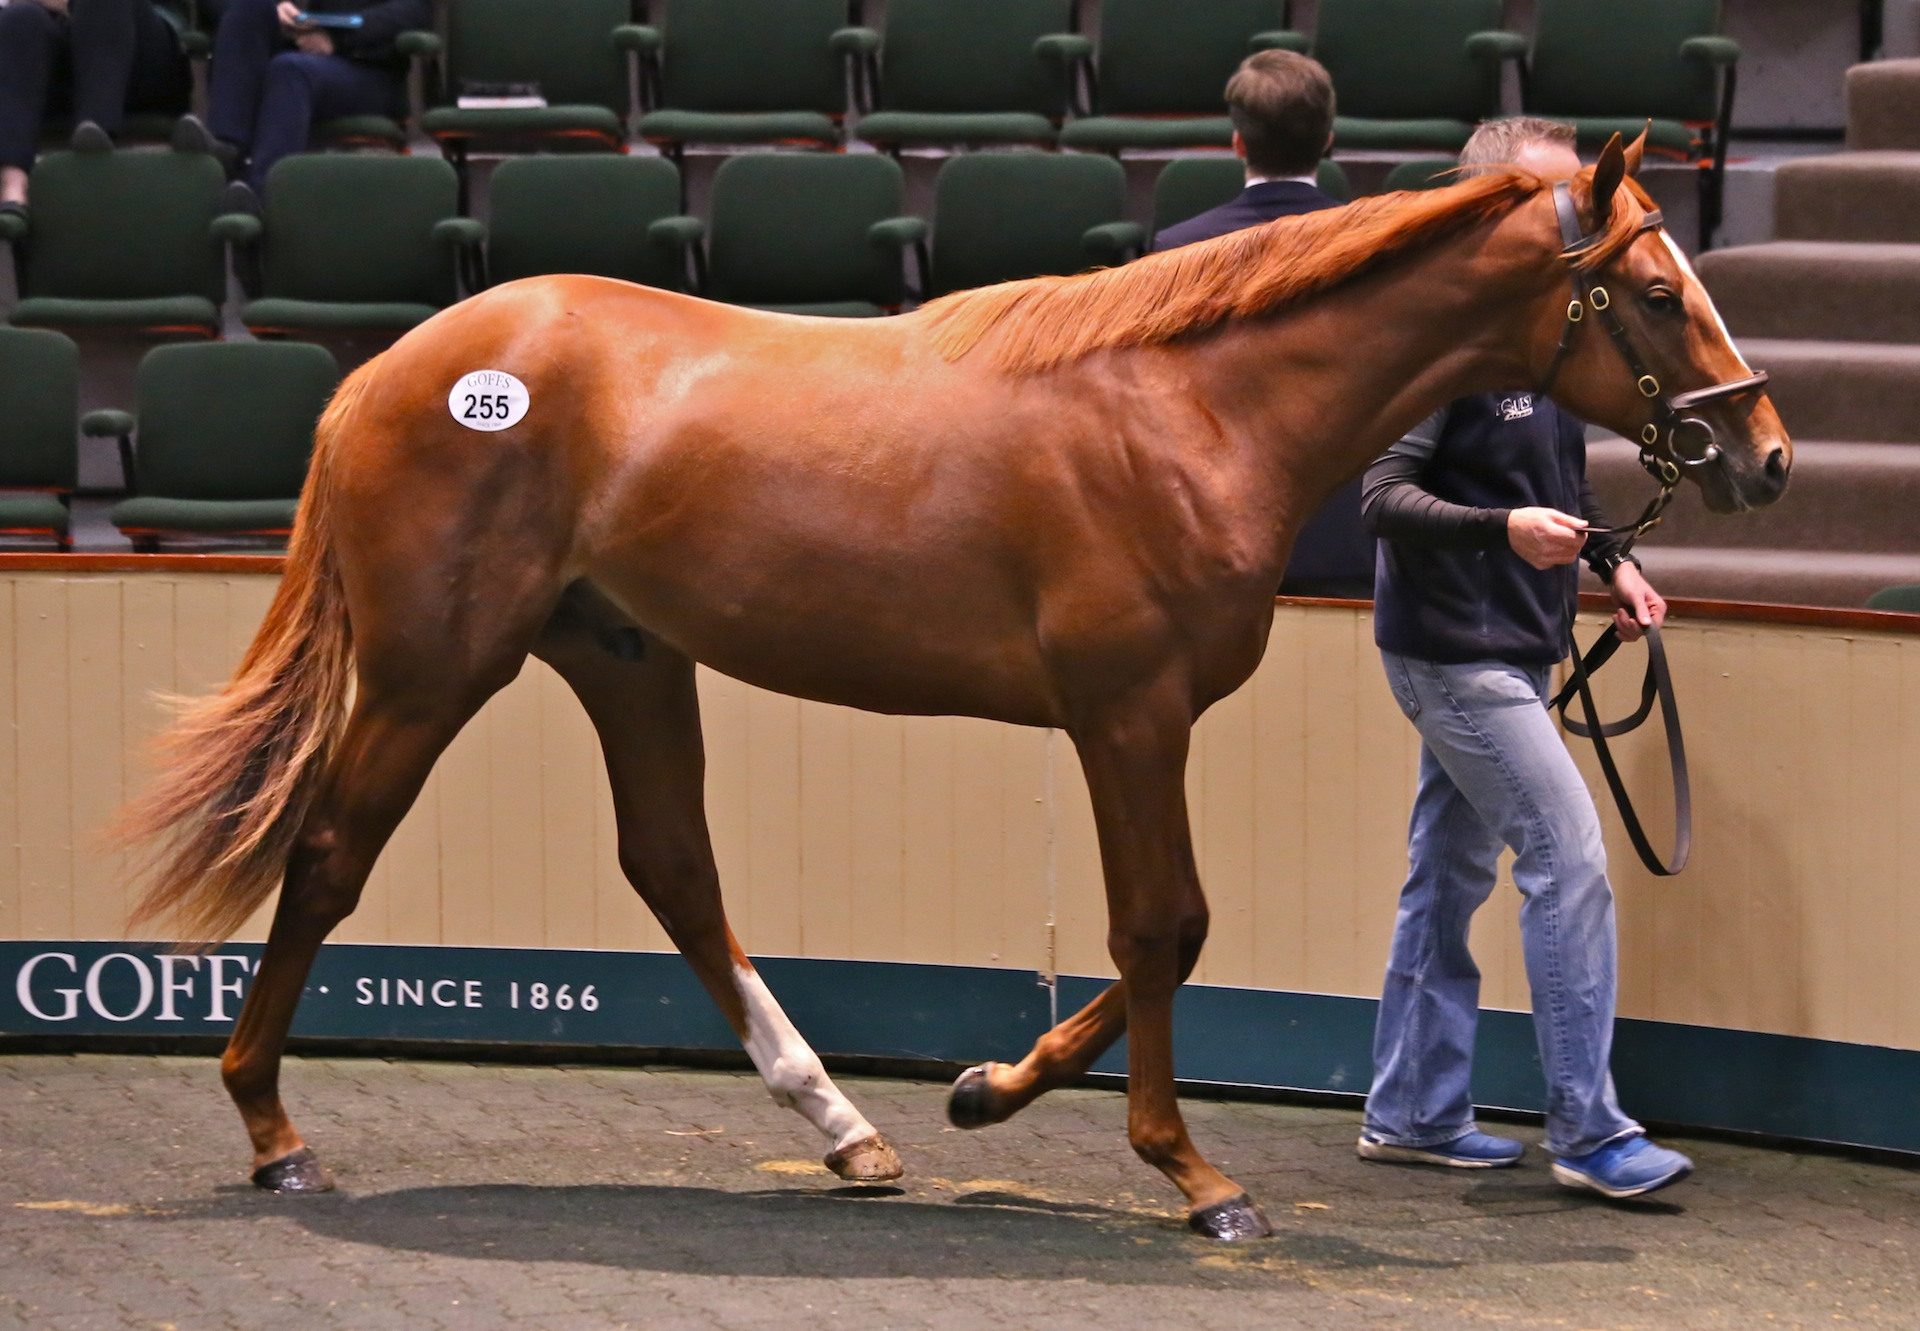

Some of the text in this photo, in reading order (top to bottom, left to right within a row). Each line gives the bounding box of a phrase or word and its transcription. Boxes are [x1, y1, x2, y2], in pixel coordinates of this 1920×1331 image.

[467, 373, 511, 389] GOFFS
[464, 394, 509, 419] 255
[16, 952, 600, 1021] GOFF SINCE 1866
